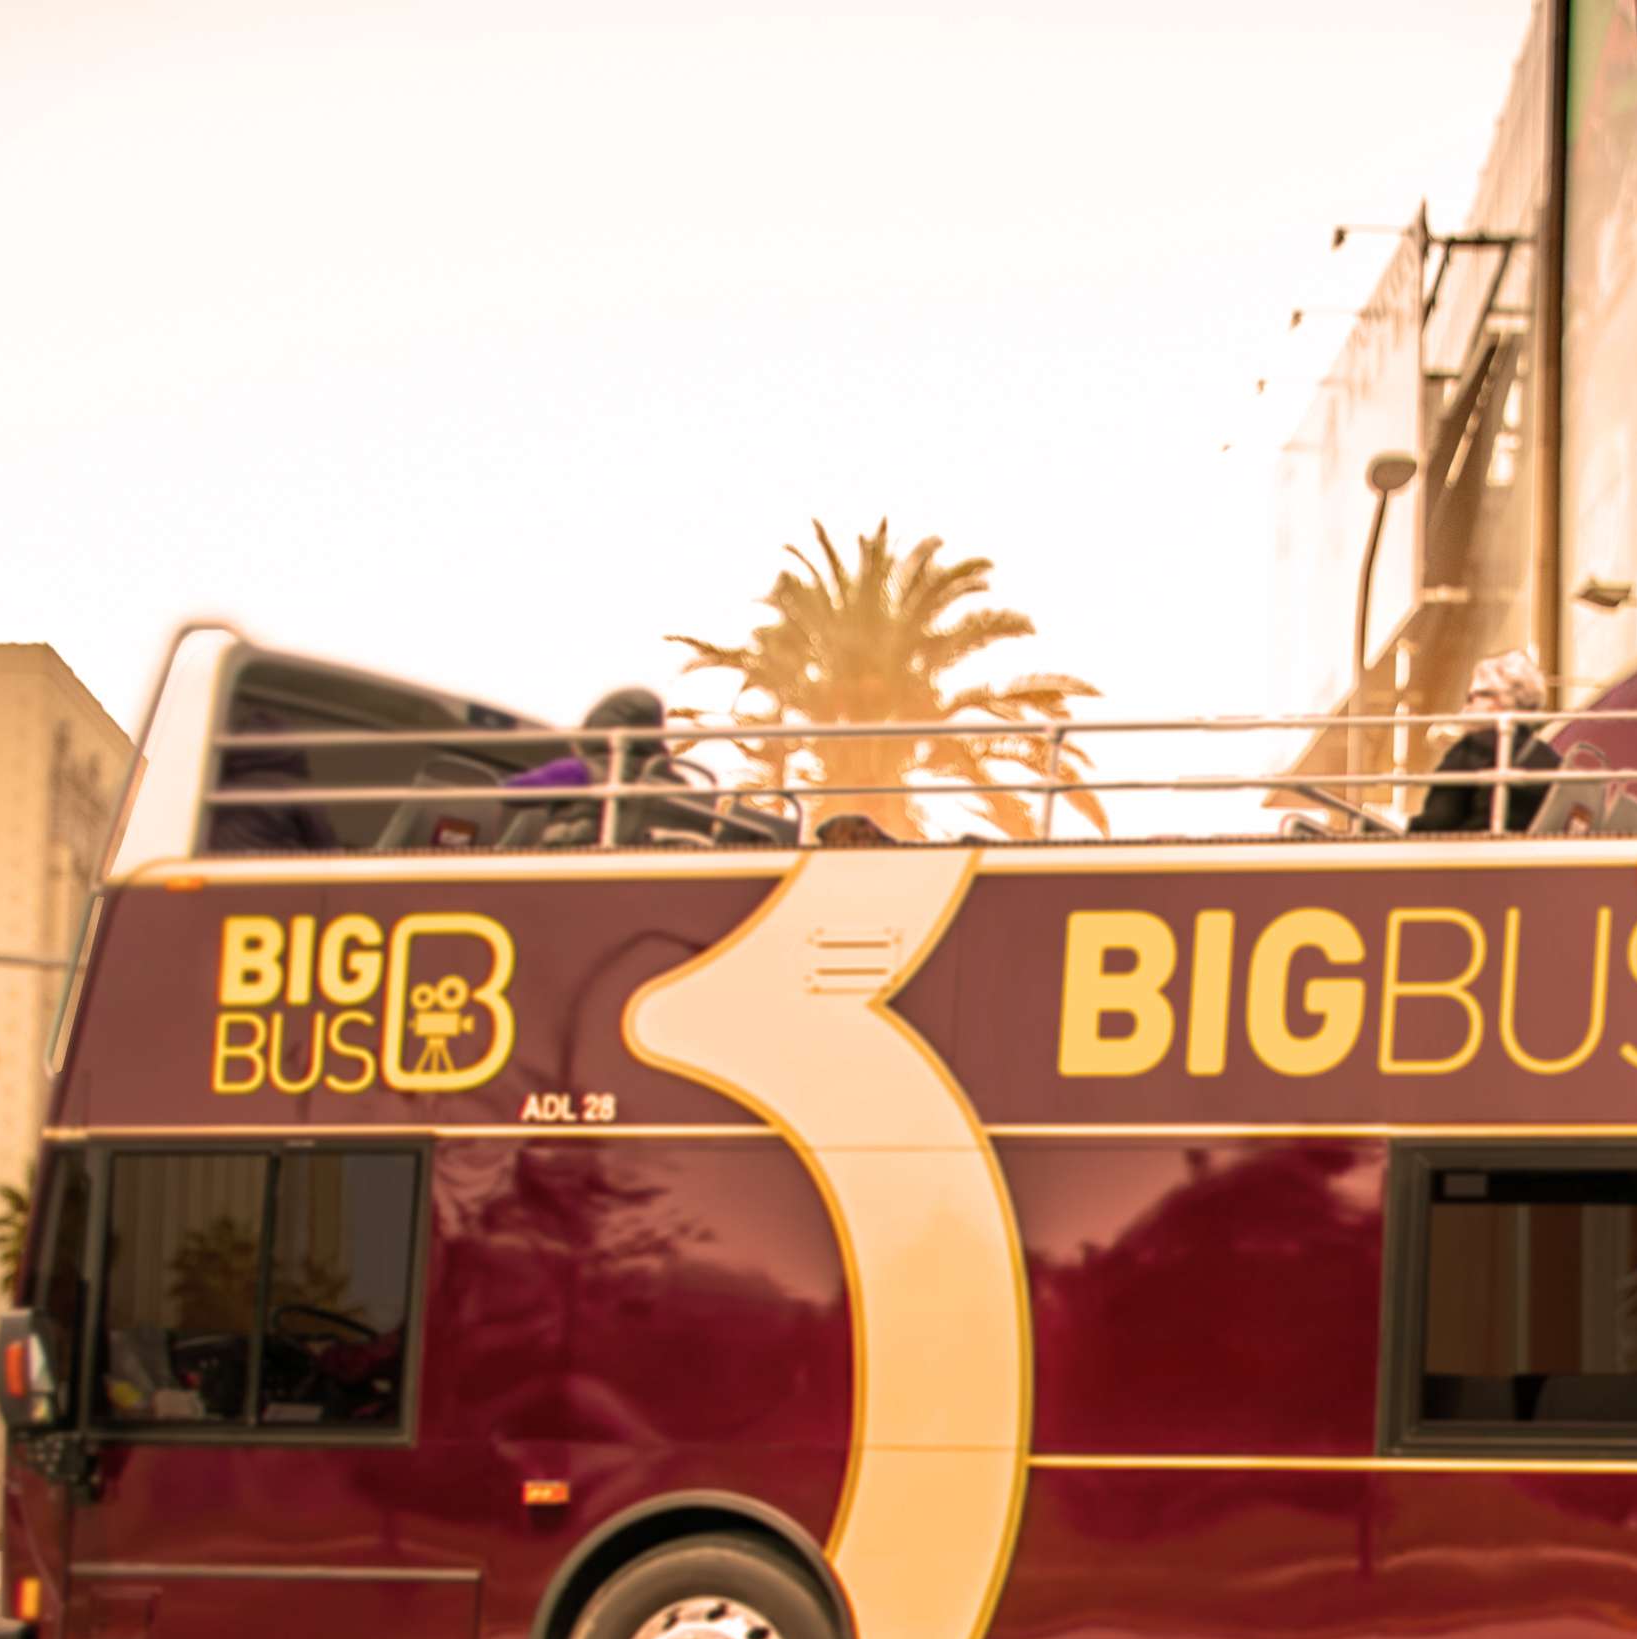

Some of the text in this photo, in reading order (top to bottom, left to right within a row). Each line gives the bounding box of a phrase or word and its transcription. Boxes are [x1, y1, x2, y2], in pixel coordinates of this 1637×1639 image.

[220, 914, 383, 1006] BIG
[212, 1010, 377, 1095] BUS
[521, 1092, 617, 1122] ADL 28
